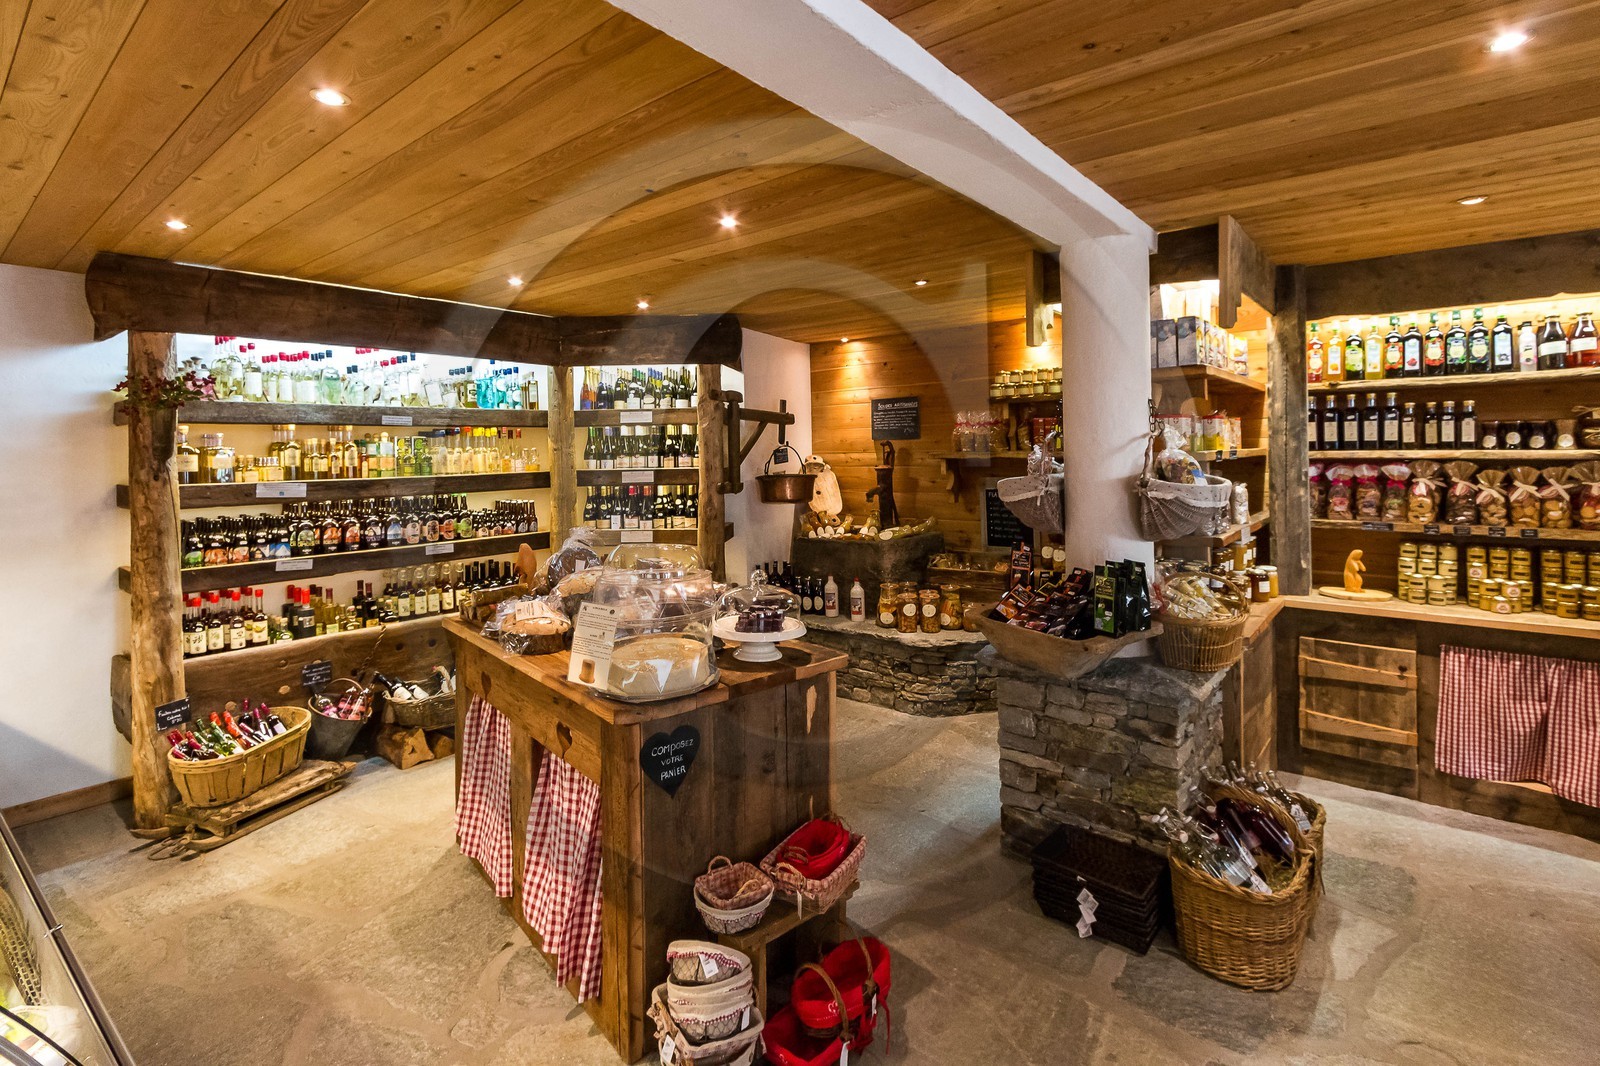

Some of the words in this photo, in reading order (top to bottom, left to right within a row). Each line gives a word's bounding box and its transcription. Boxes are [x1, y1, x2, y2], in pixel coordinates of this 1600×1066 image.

[651, 739, 693, 756] COMPOSEZ
[660, 753, 684, 766] VOTRE
[660, 765, 686, 781] PANIER
